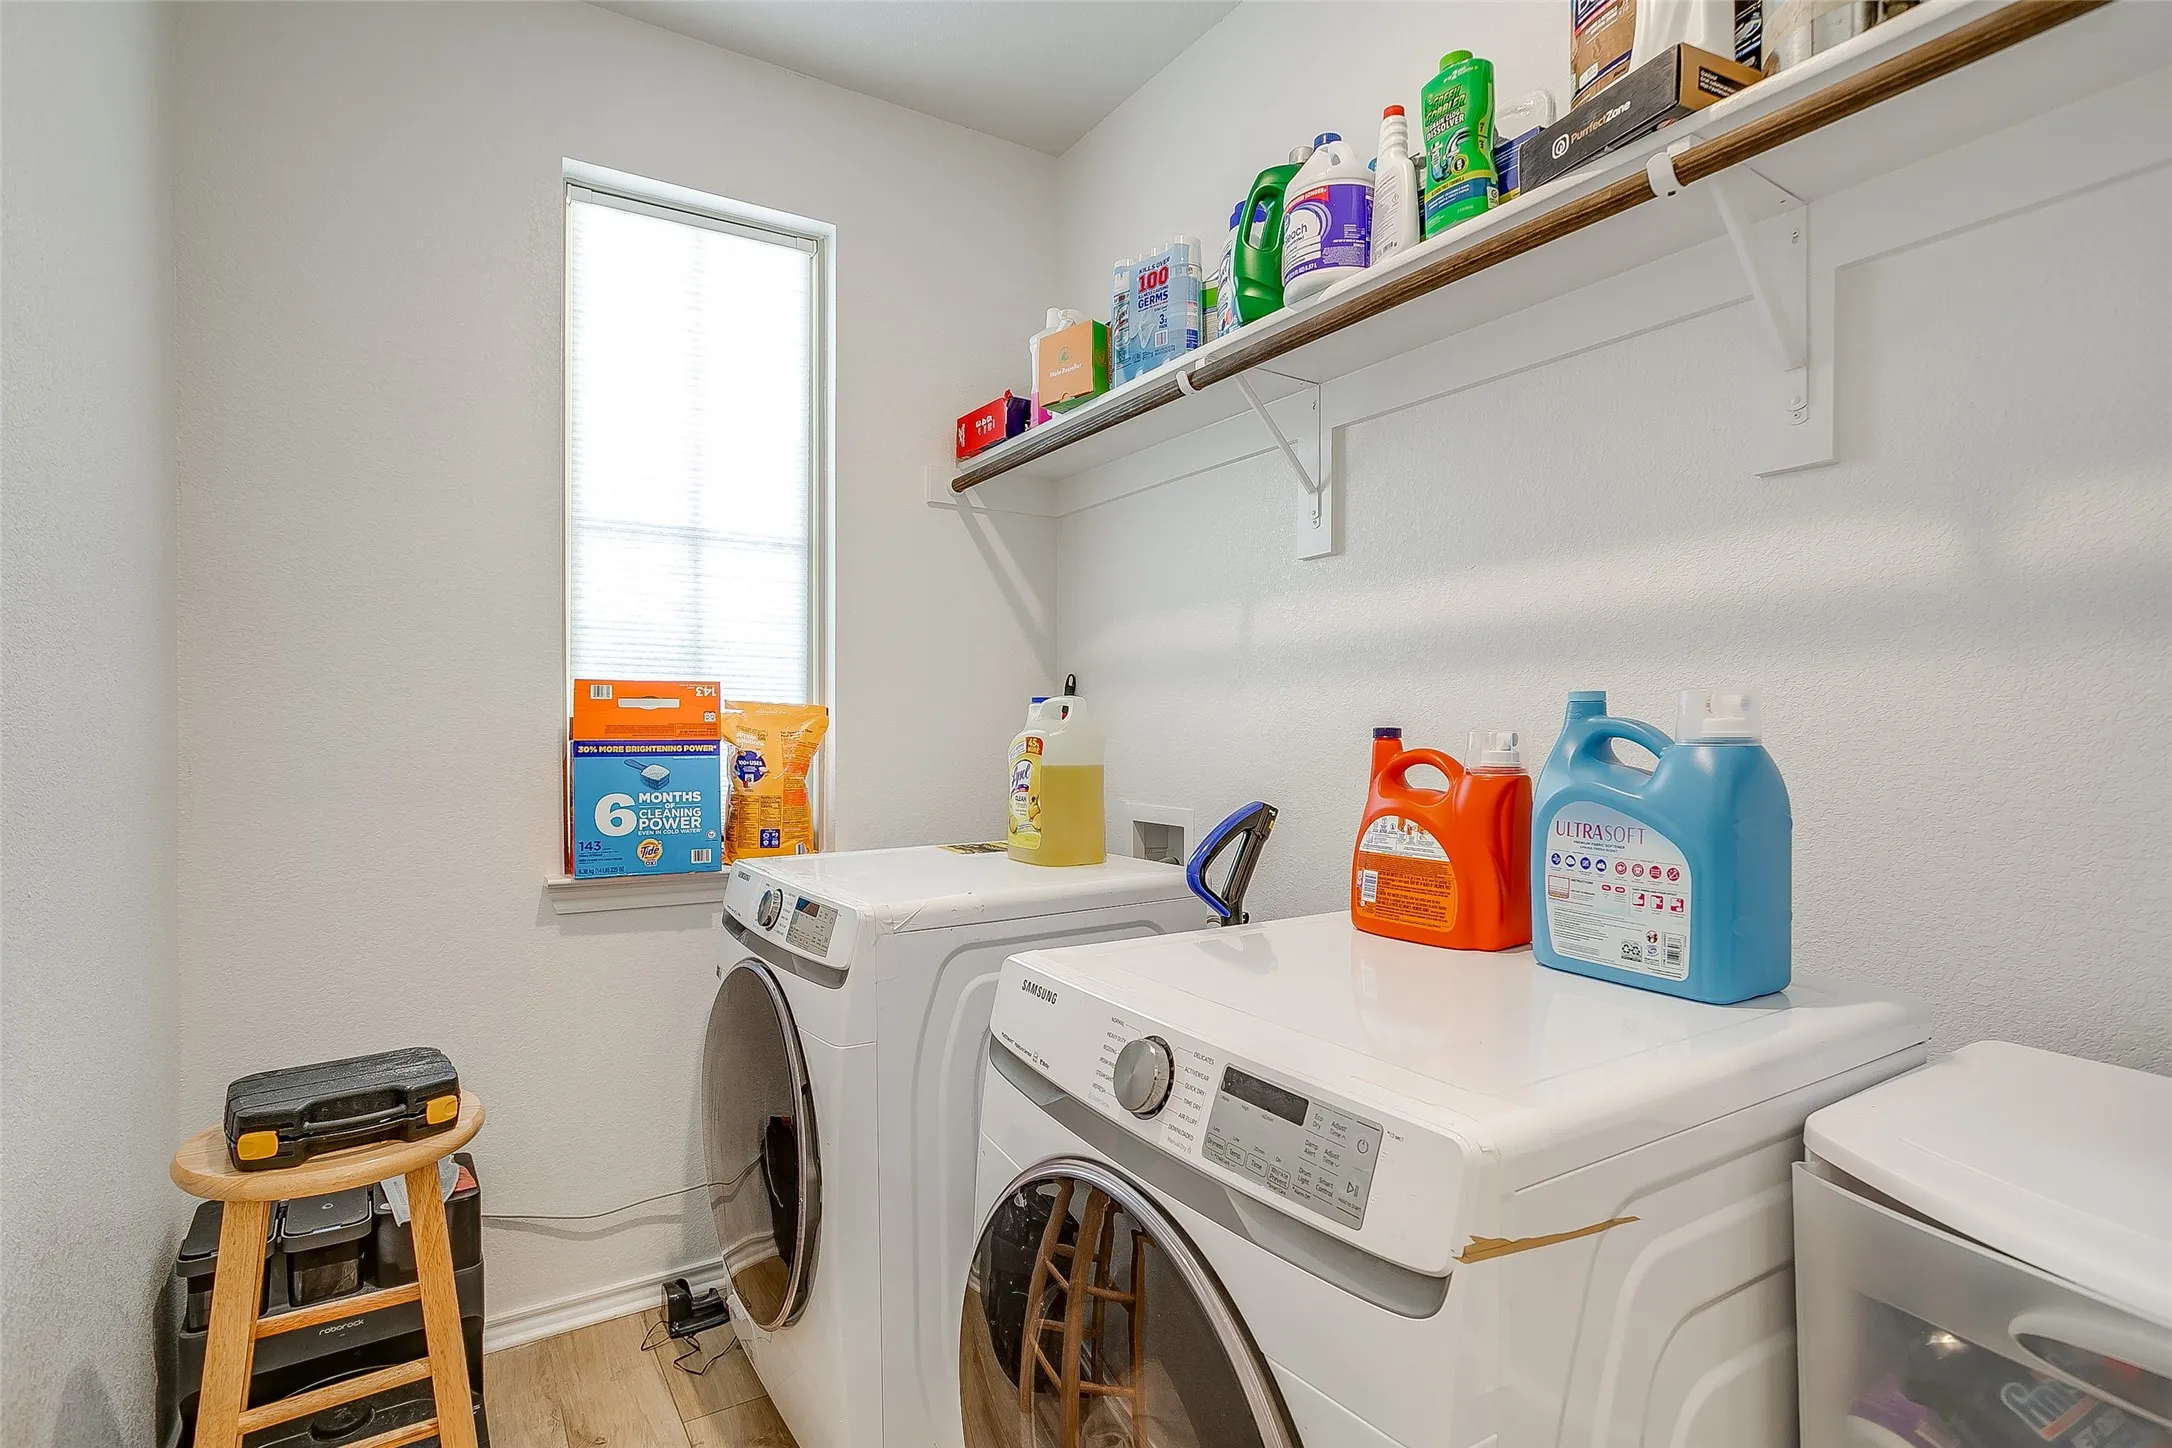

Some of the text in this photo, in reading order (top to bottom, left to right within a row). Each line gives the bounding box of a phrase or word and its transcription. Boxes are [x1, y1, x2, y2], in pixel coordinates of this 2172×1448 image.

[1433, 84, 1462, 106] GREEN
[1425, 93, 1467, 127] GOBBLER
[1426, 113, 1465, 141] DISSOLVER
[1570, 100, 1631, 144] PurrfectZone
[1139, 256, 1171, 275] KILLS OVER
[1138, 266, 1169, 294] 100
[1138, 290, 1169, 309] GERMS
[695, 686, 717, 697] 143
[578, 745, 598, 753] 30%
[598, 745, 625, 753] MORE
[625, 745, 682, 753] BRIGHTENING
[1012, 763, 1031, 788] Lysol
[638, 791, 701, 804] MONTHS
[594, 792, 637, 837] 6
[639, 807, 701, 819] CLEANING
[638, 816, 701, 831] POWER
[1556, 820, 1646, 845] ULTRASOFT
[578, 840, 601, 851] 143
[640, 845, 660, 859] Tide
[1021, 979, 1058, 1005] SAMSUNG
[1193, 1051, 1215, 1066] DELICATES
[1184, 1066, 1210, 1082] ACTIVEWEAR
[1184, 1082, 1205, 1097] QUICK DRY
[1183, 1098, 1202, 1111] TIME DRY
[1178, 1112, 1198, 1126] AIR FLUFF
[1314, 1113, 1323, 1122] Eco
[1312, 1120, 1321, 1130] Dry
[1331, 1121, 1347, 1133] Adjust
[1167, 1123, 1194, 1142] DOWNLOADED
[1329, 1128, 1341, 1138] Time
[1207, 1137, 1224, 1151] Dryness
[1304, 1139, 1319, 1151] Damp
[1303, 1147, 1316, 1158] Alert
[1324, 1149, 1340, 1161] Adjust
[1250, 1159, 1263, 1171] Time
[1322, 1156, 1334, 1166] Time
[1298, 1166, 1312, 1177] Drum
[1269, 1173, 1288, 1188] Prevent
[1297, 1174, 1310, 1186] Light
[1319, 1177, 1334, 1189] Smart
[1315, 1184, 1334, 1197] Control
[318, 1319, 364, 1336] roborock
